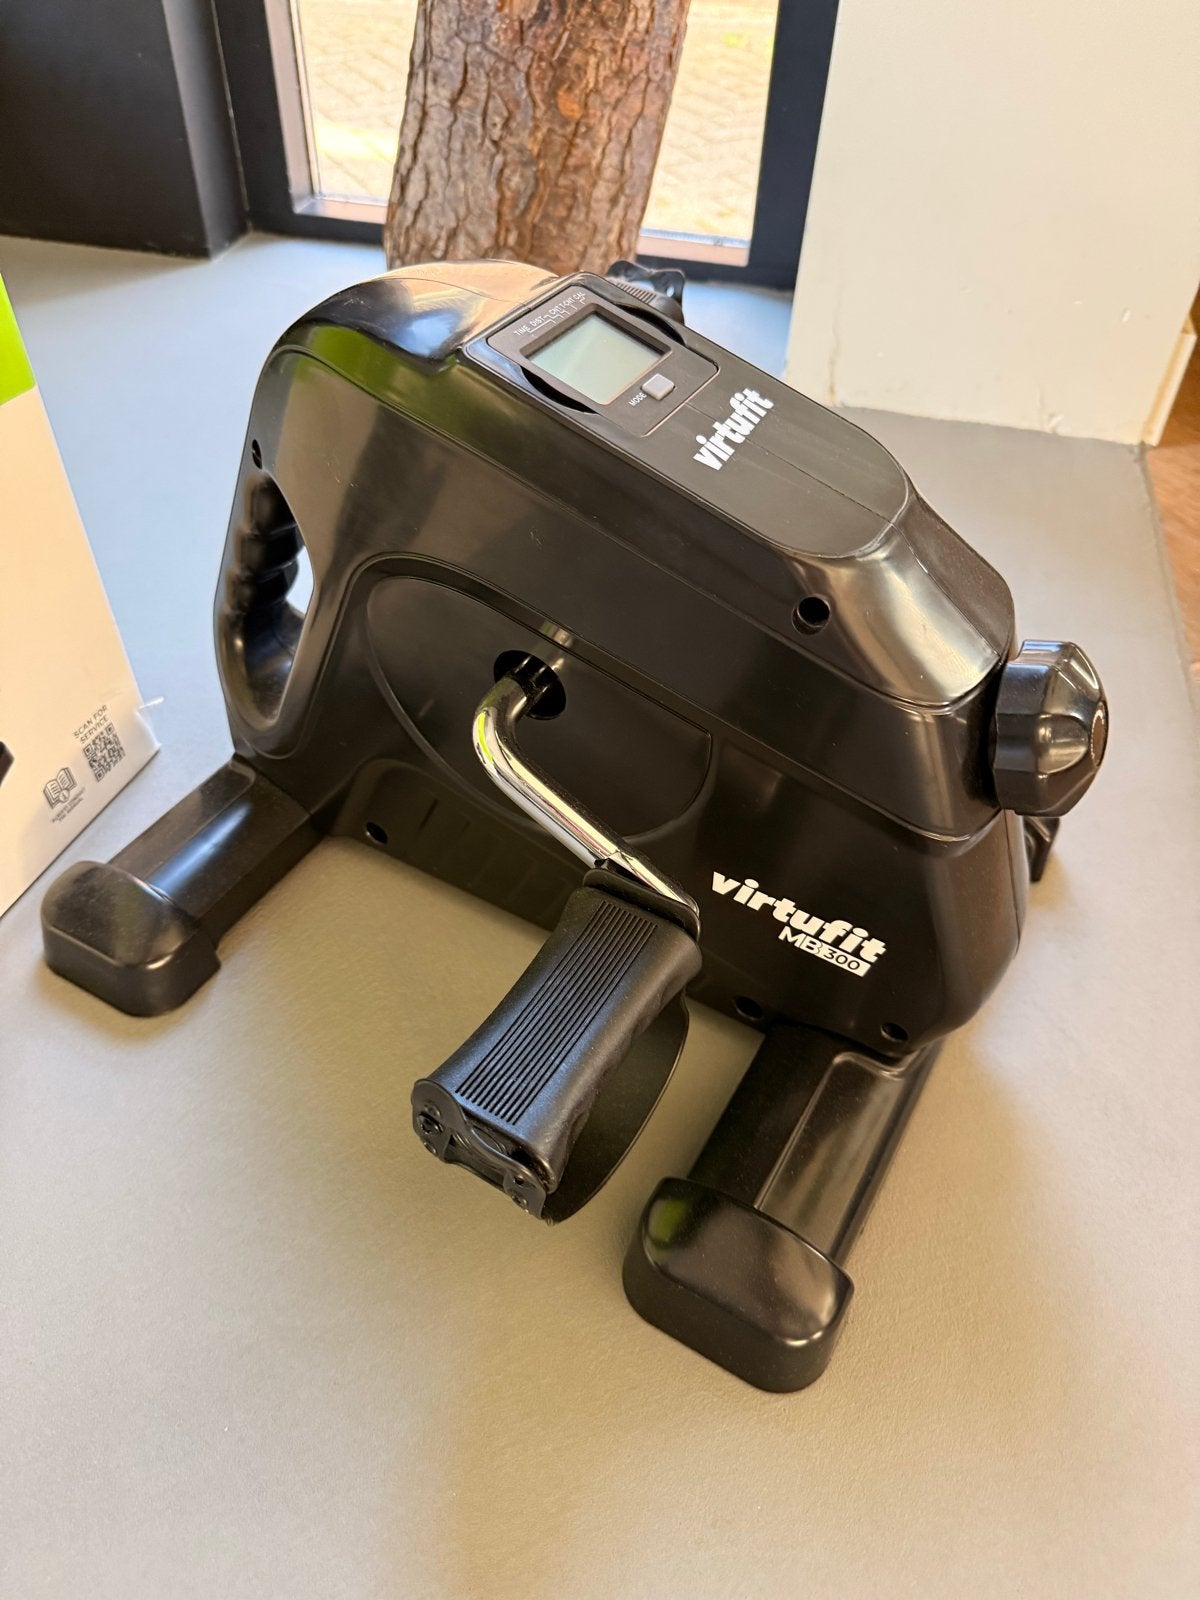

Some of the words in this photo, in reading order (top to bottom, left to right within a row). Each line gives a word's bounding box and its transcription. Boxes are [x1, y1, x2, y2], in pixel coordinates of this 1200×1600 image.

[513, 325, 531, 336] TIME
[529, 315, 545, 327] DIST
[628, 391, 647, 407] MODE
[693, 388, 774, 470] virtufit
[74, 718, 93, 739] SCAN
[93, 705, 107, 720] FOR
[80, 714, 107, 743] SERVICE
[711, 871, 887, 963] virtufit
